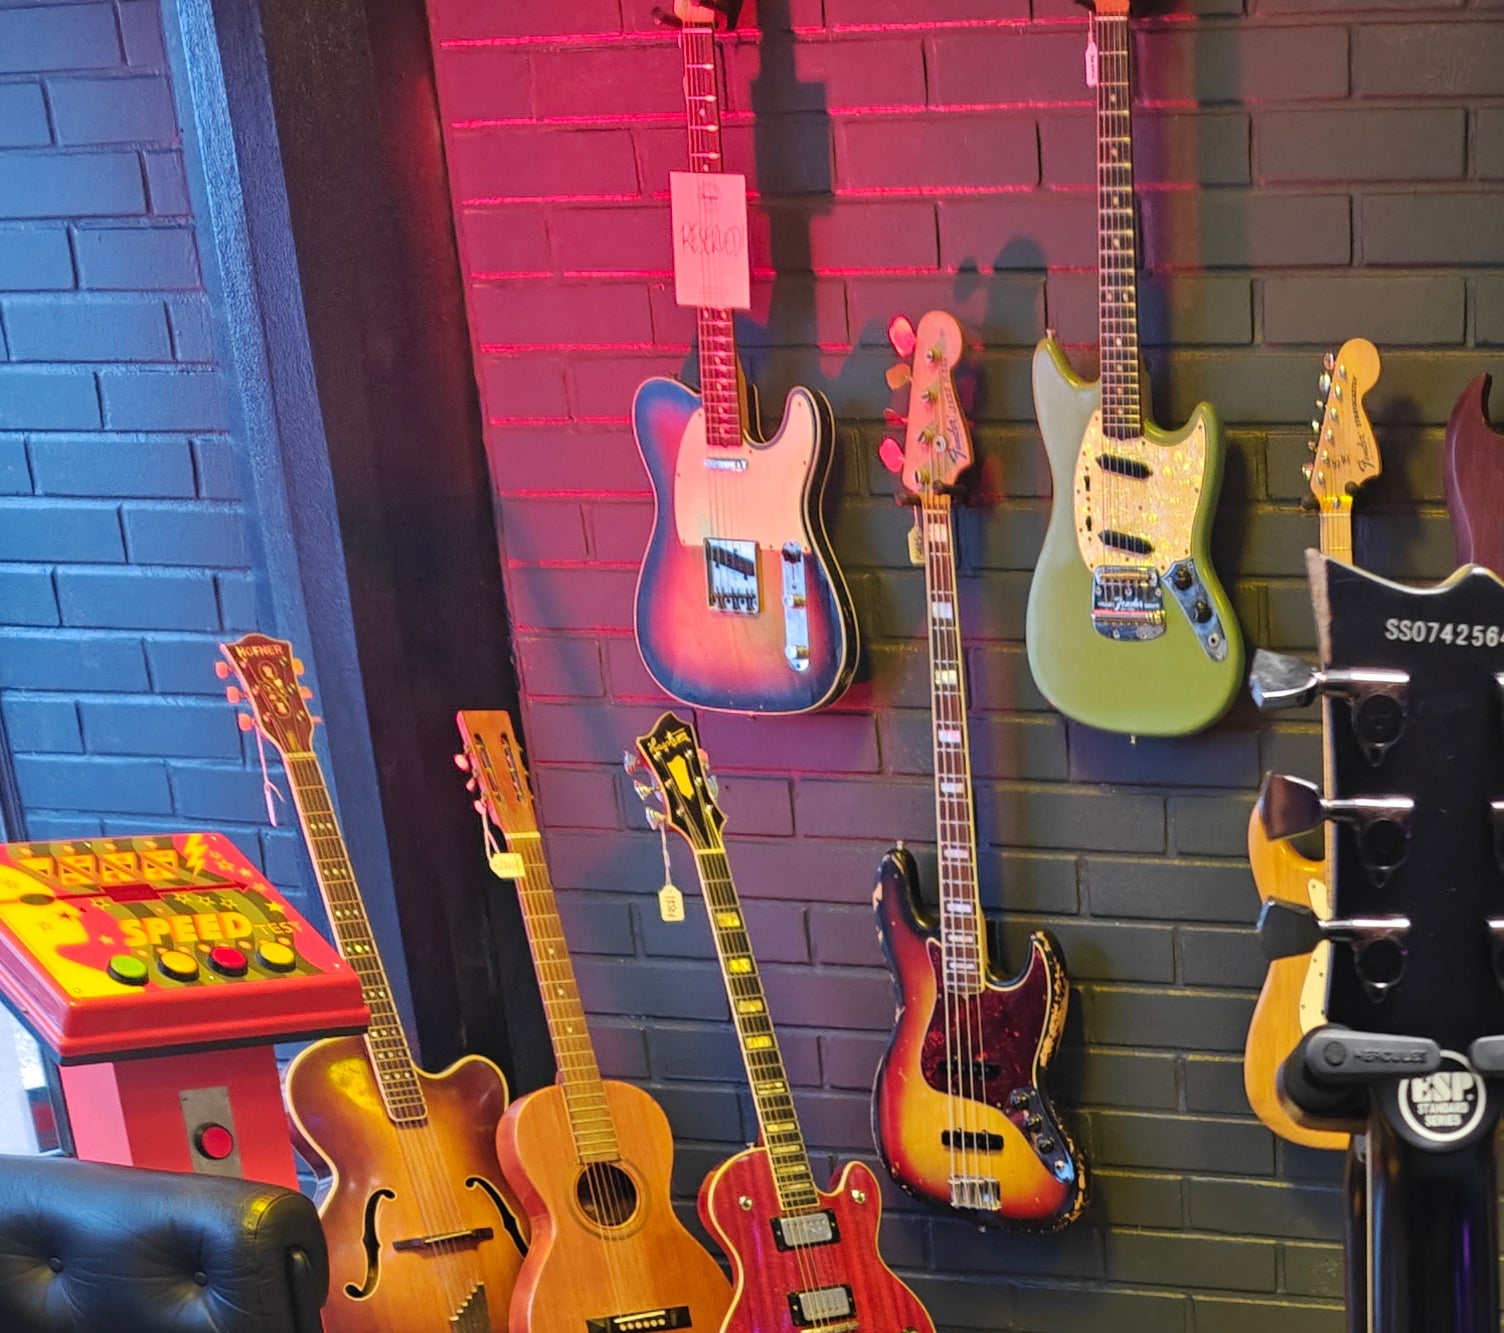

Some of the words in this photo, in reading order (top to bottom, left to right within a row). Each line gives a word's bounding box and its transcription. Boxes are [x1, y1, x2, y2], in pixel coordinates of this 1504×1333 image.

[118, 911, 253, 947] SPEED
[253, 920, 303, 936] TEST
[1354, 1050, 1427, 1064] HERCULES
[1417, 1101, 1470, 1116] STANDARD
[1424, 1114, 1463, 1128] SERIES
